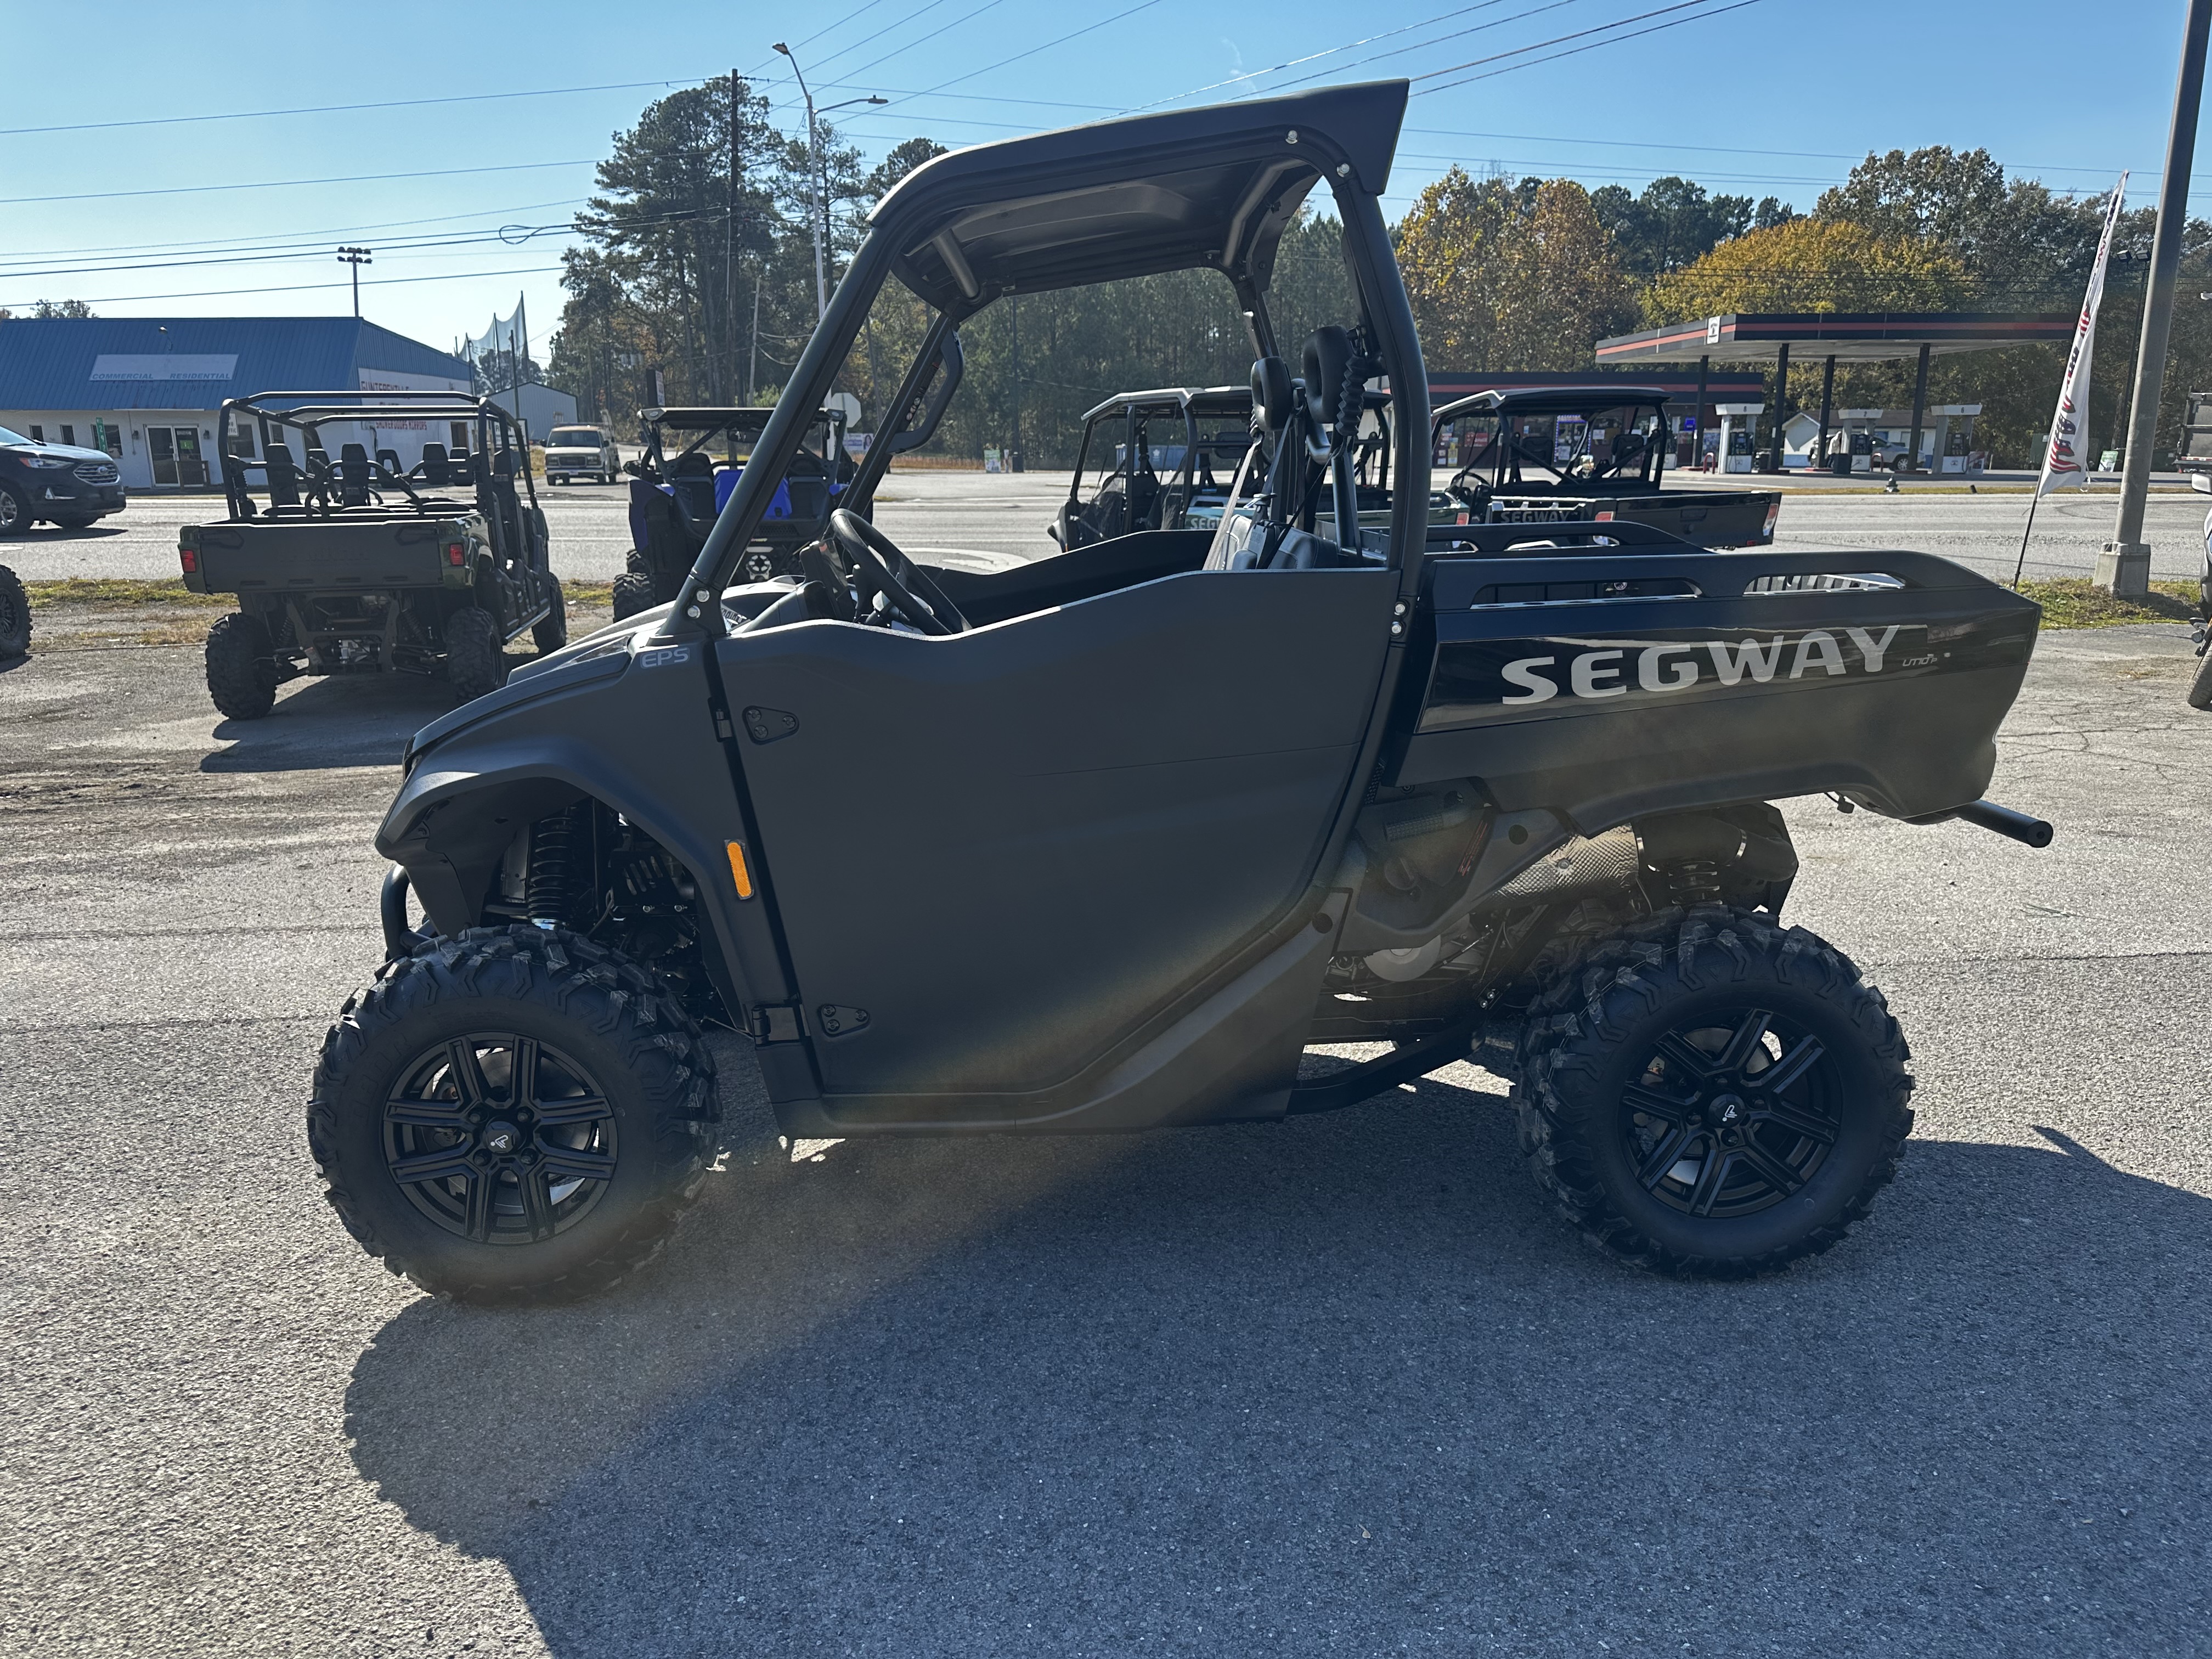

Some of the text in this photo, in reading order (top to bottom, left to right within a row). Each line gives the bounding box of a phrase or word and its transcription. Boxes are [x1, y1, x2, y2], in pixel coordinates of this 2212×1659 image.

[1190, 518, 1221, 529] SEG
[1500, 511, 1570, 523] SEGWAY
[642, 648, 689, 668] EPS
[1501, 624, 1900, 704] SEGWAY
